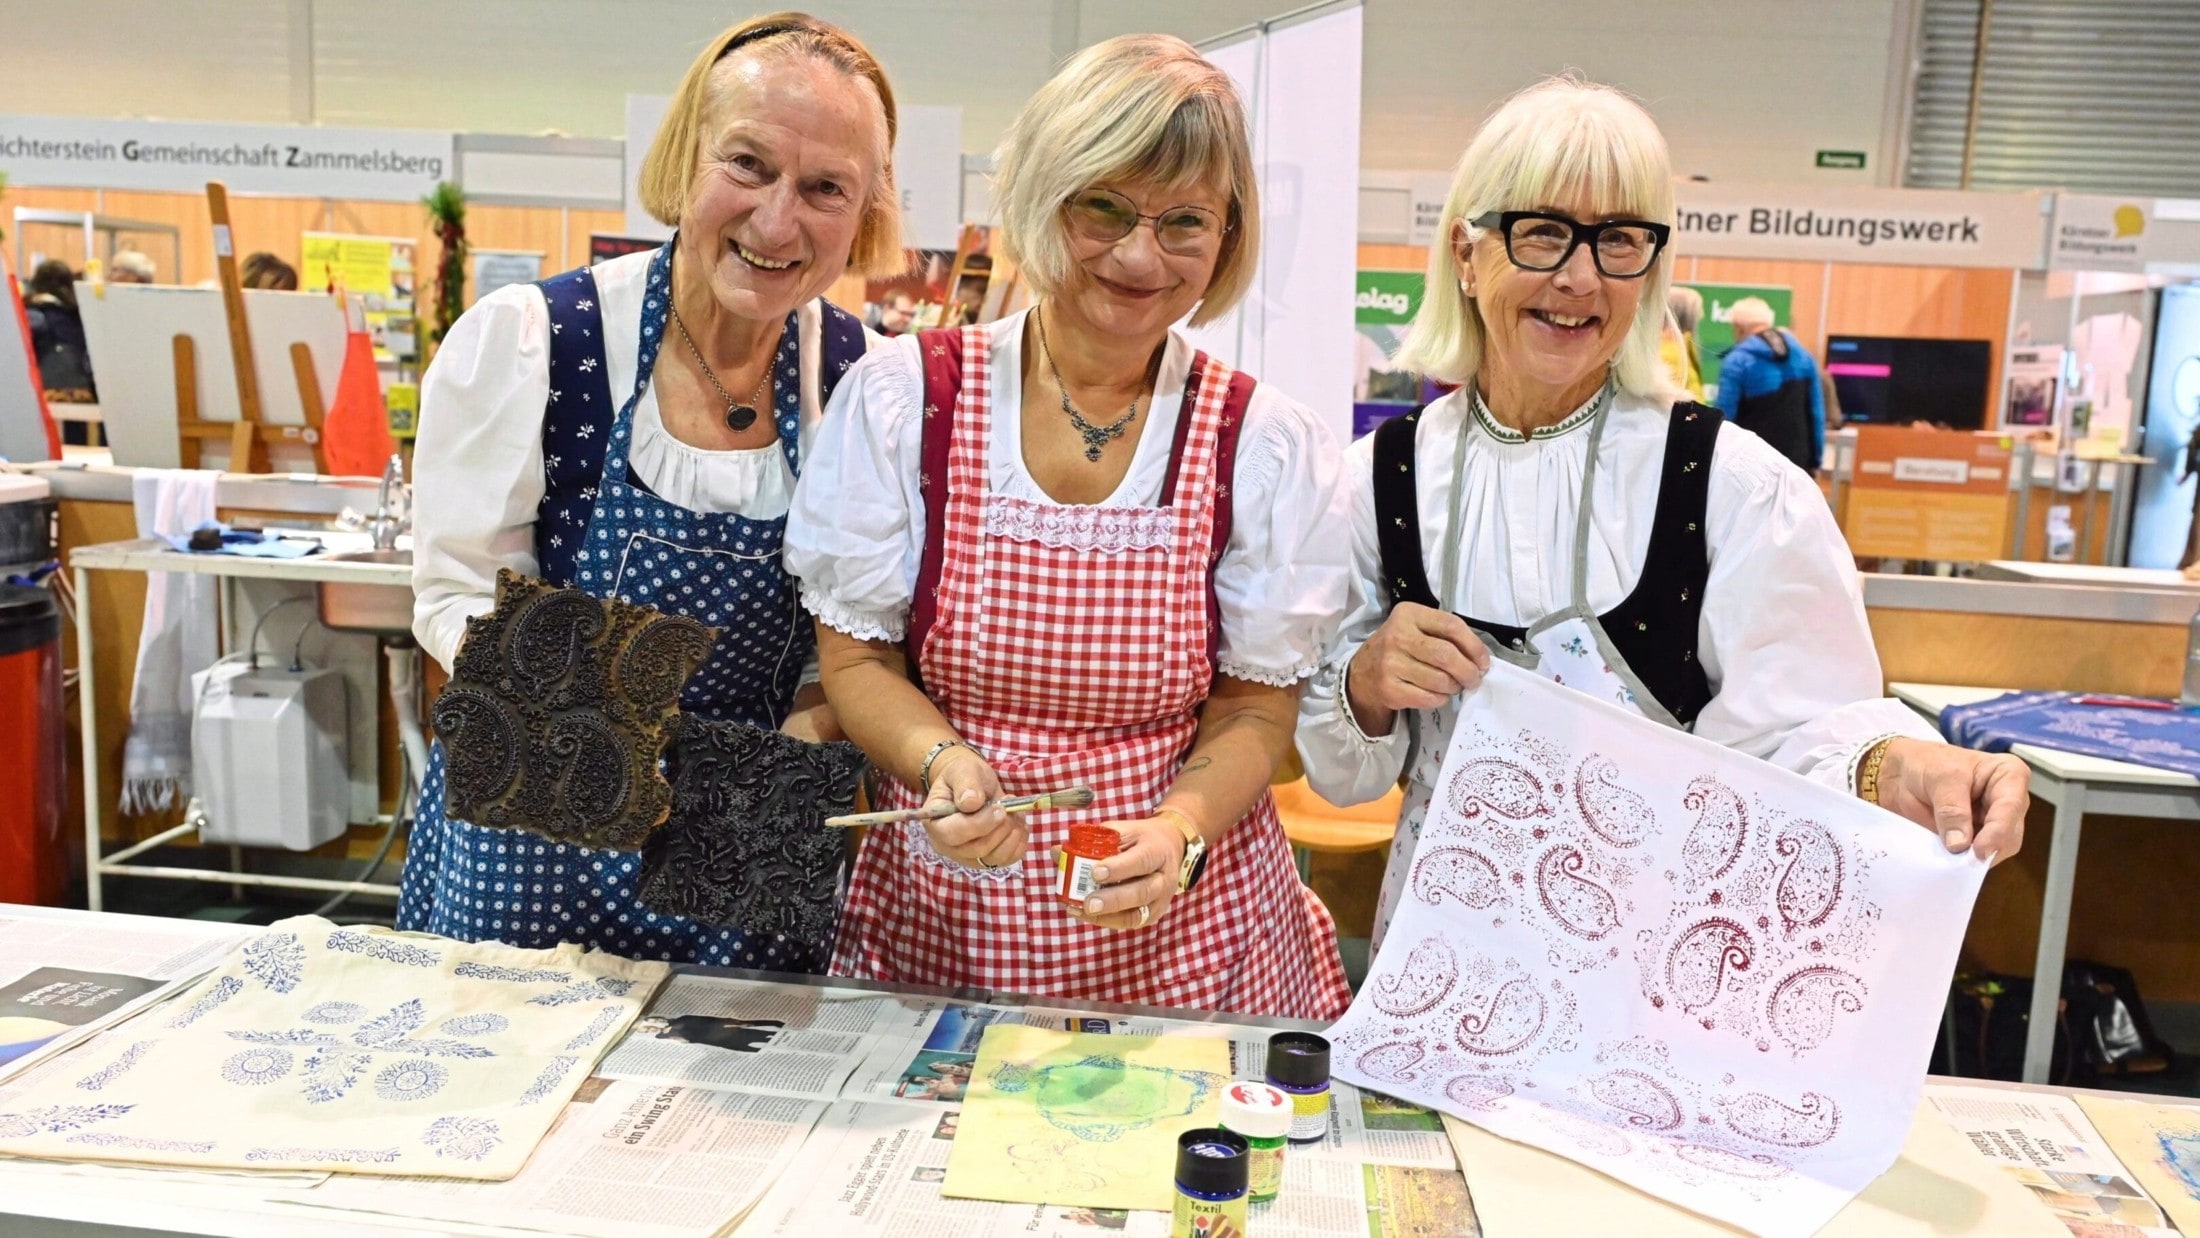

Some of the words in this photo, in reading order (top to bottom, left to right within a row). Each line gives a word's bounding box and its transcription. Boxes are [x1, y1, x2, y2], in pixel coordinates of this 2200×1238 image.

[0, 136, 116, 160] ichterstein
[122, 140, 278, 167] Gemeinschaft
[285, 146, 443, 181] Zammelsberg
[1677, 207, 1739, 233] tner
[1750, 208, 1979, 246] Bildungswerk
[1356, 286, 1409, 315] elag
[602, 1118, 633, 1138] Ganz
[634, 1104, 671, 1130] Swing
[623, 1131, 646, 1145] ein
[1190, 1200, 1222, 1213] Textil
